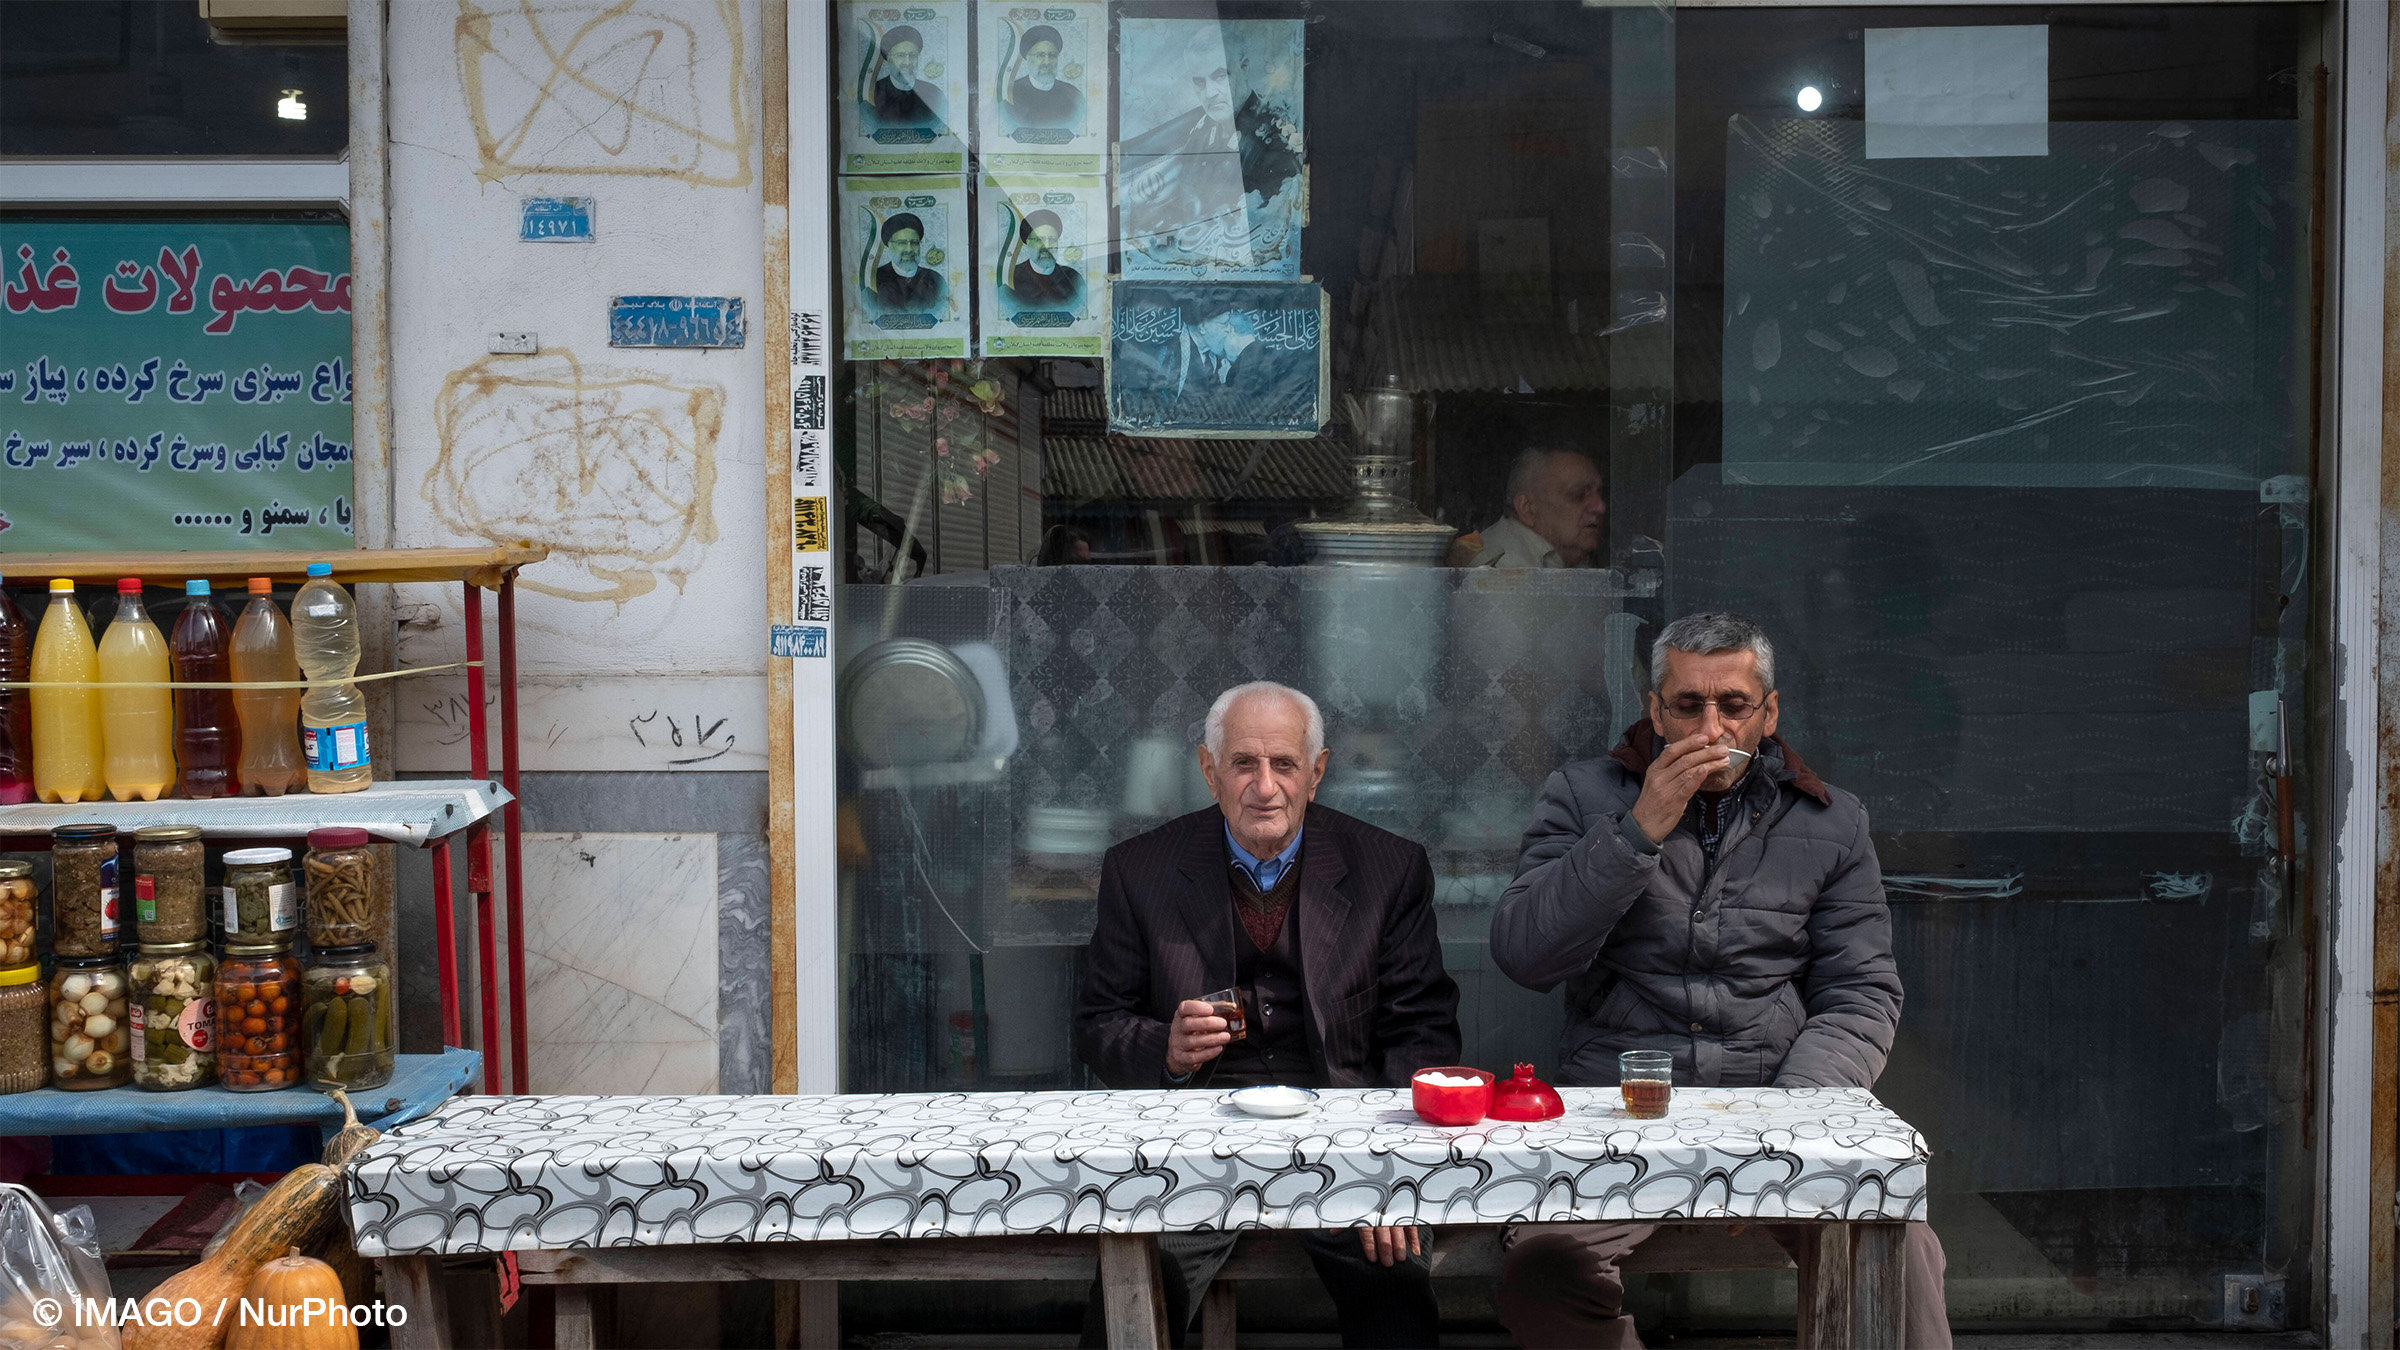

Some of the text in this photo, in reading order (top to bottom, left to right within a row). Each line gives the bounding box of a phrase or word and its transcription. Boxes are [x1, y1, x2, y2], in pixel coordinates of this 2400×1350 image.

[4, 243, 80, 314] غذ
[23, 356, 67, 404] پیاز
[95, 357, 160, 402] کرده
[168, 359, 223, 402] سرخ
[234, 362, 300, 402] سبزی
[5, 431, 51, 468] سرخ
[55, 440, 91, 469] سیر
[114, 432, 163, 471] کرده
[235, 432, 290, 471] کبابی
[260, 499, 310, 534] سمنو
